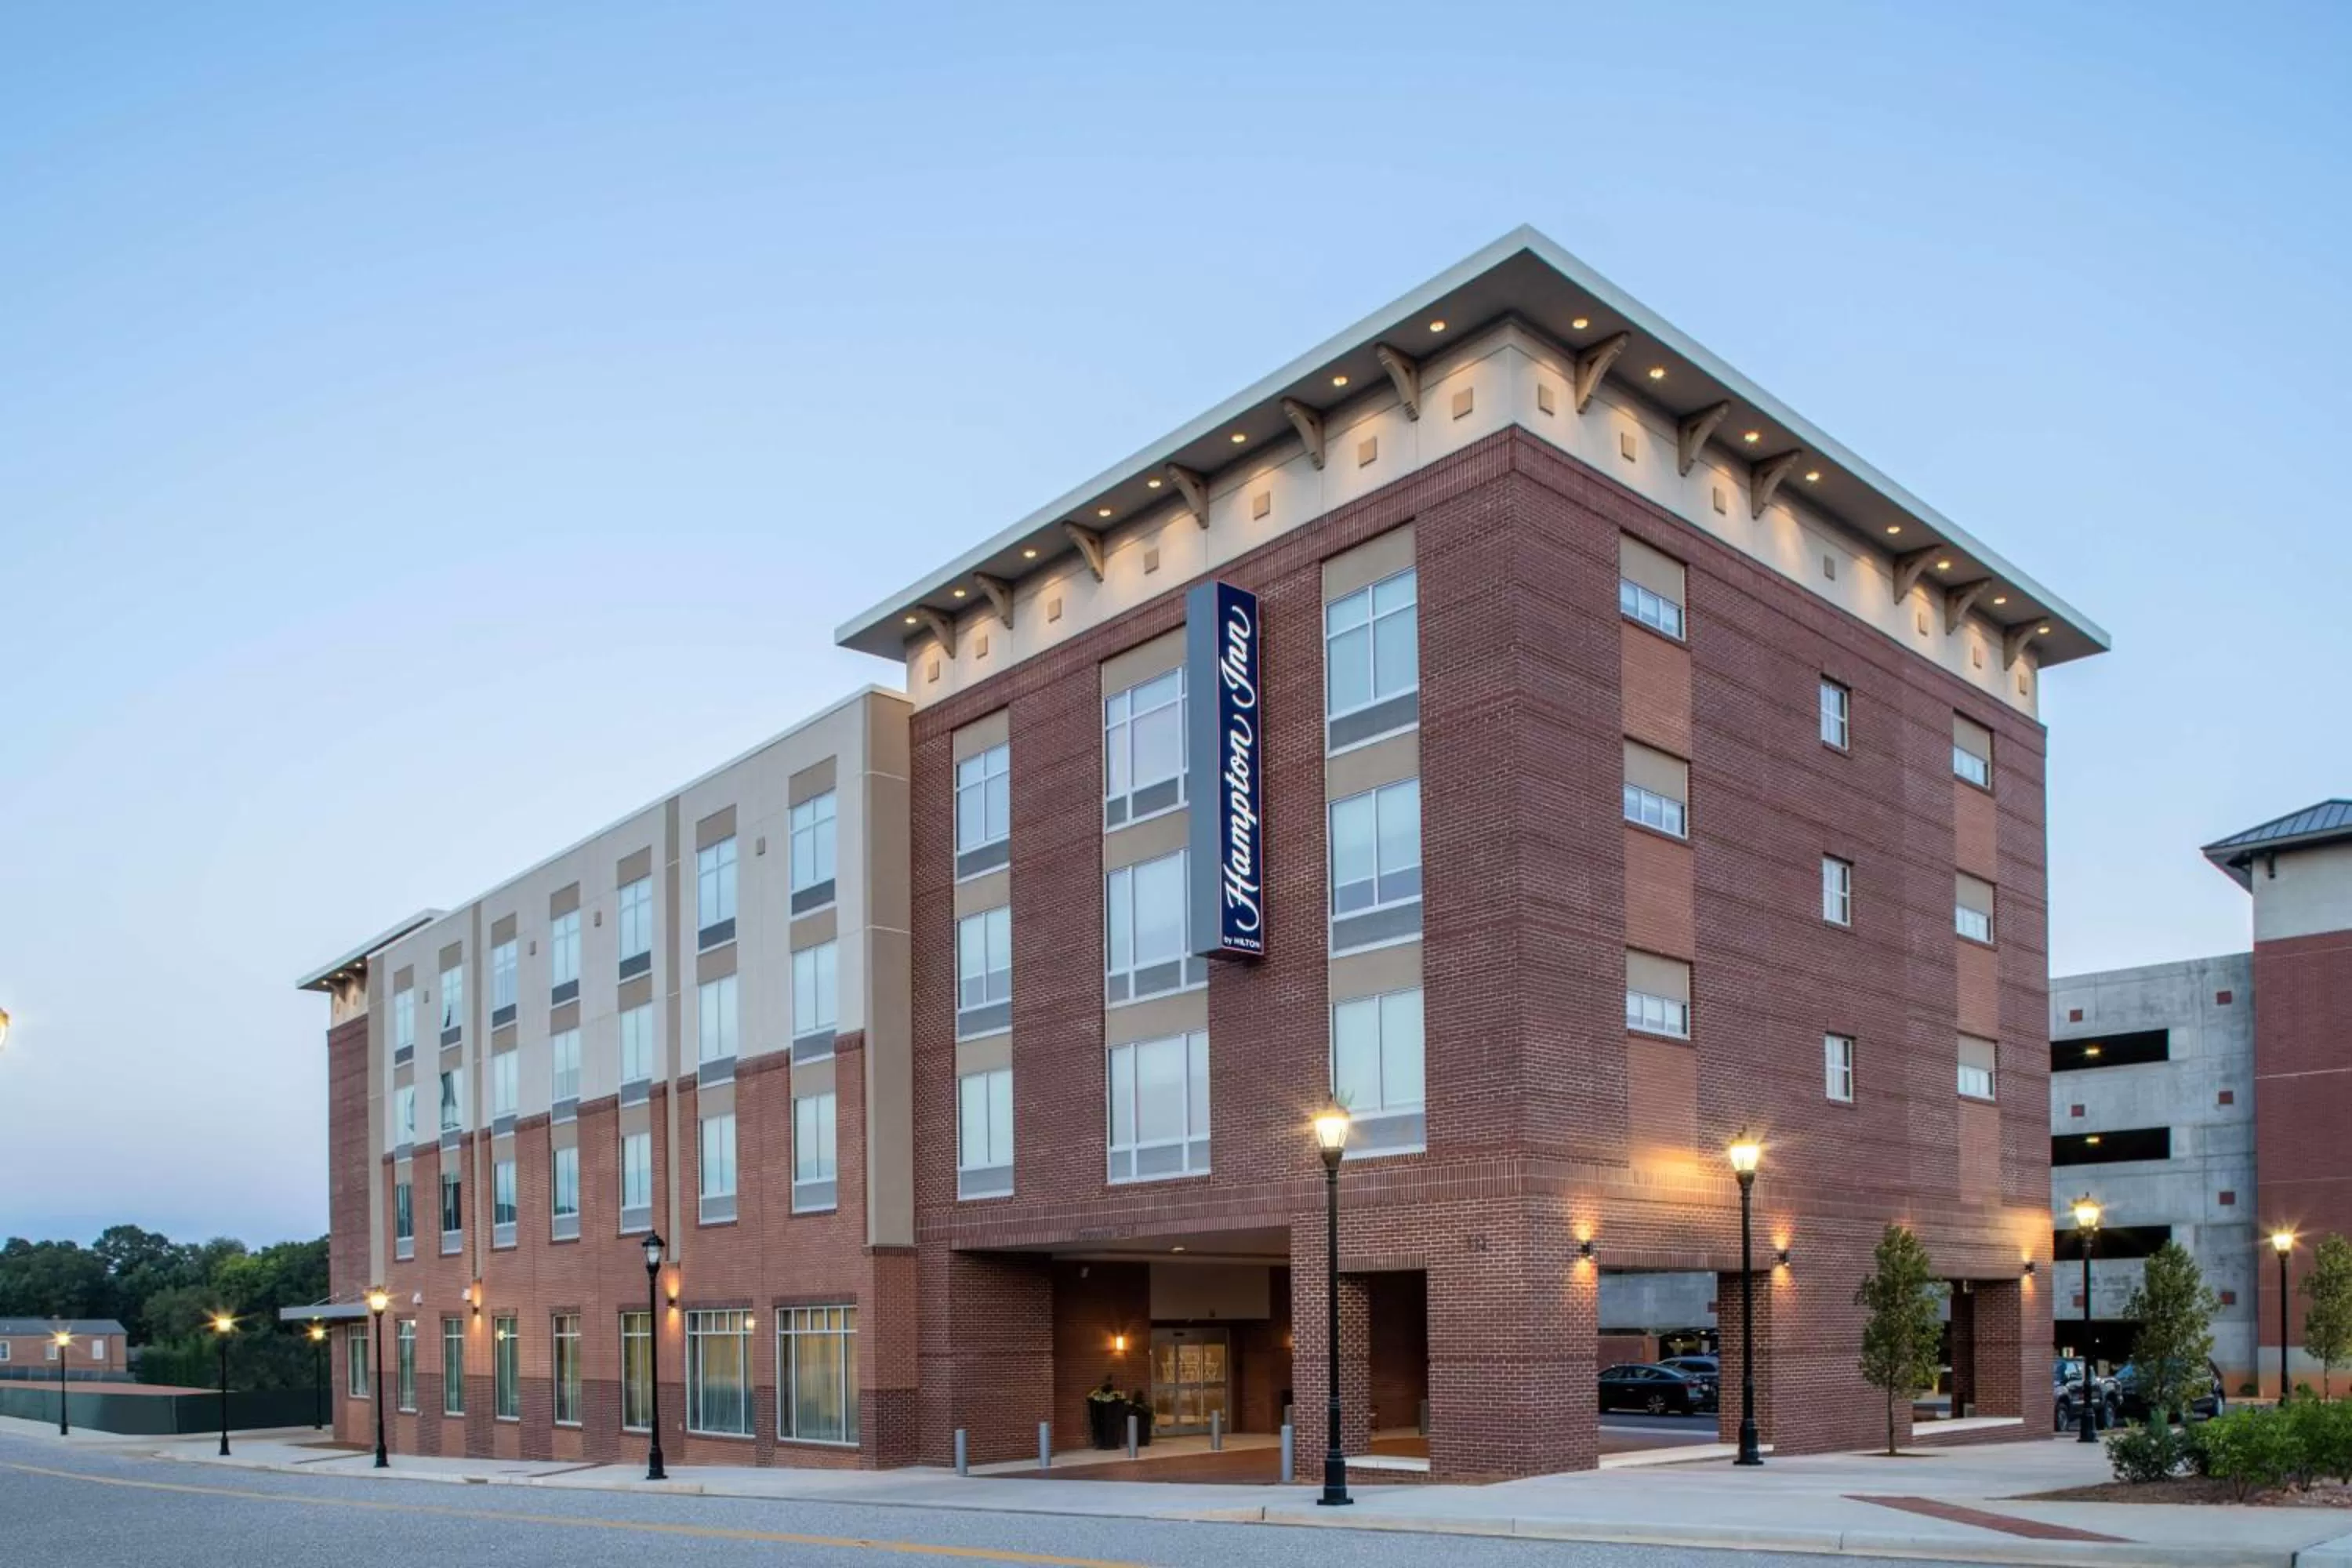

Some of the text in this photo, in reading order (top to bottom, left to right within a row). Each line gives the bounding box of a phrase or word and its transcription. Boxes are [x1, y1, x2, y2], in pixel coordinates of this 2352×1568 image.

[1221, 605, 1259, 931] Hampton Inn
[1233, 936, 1260, 949] HILTON
